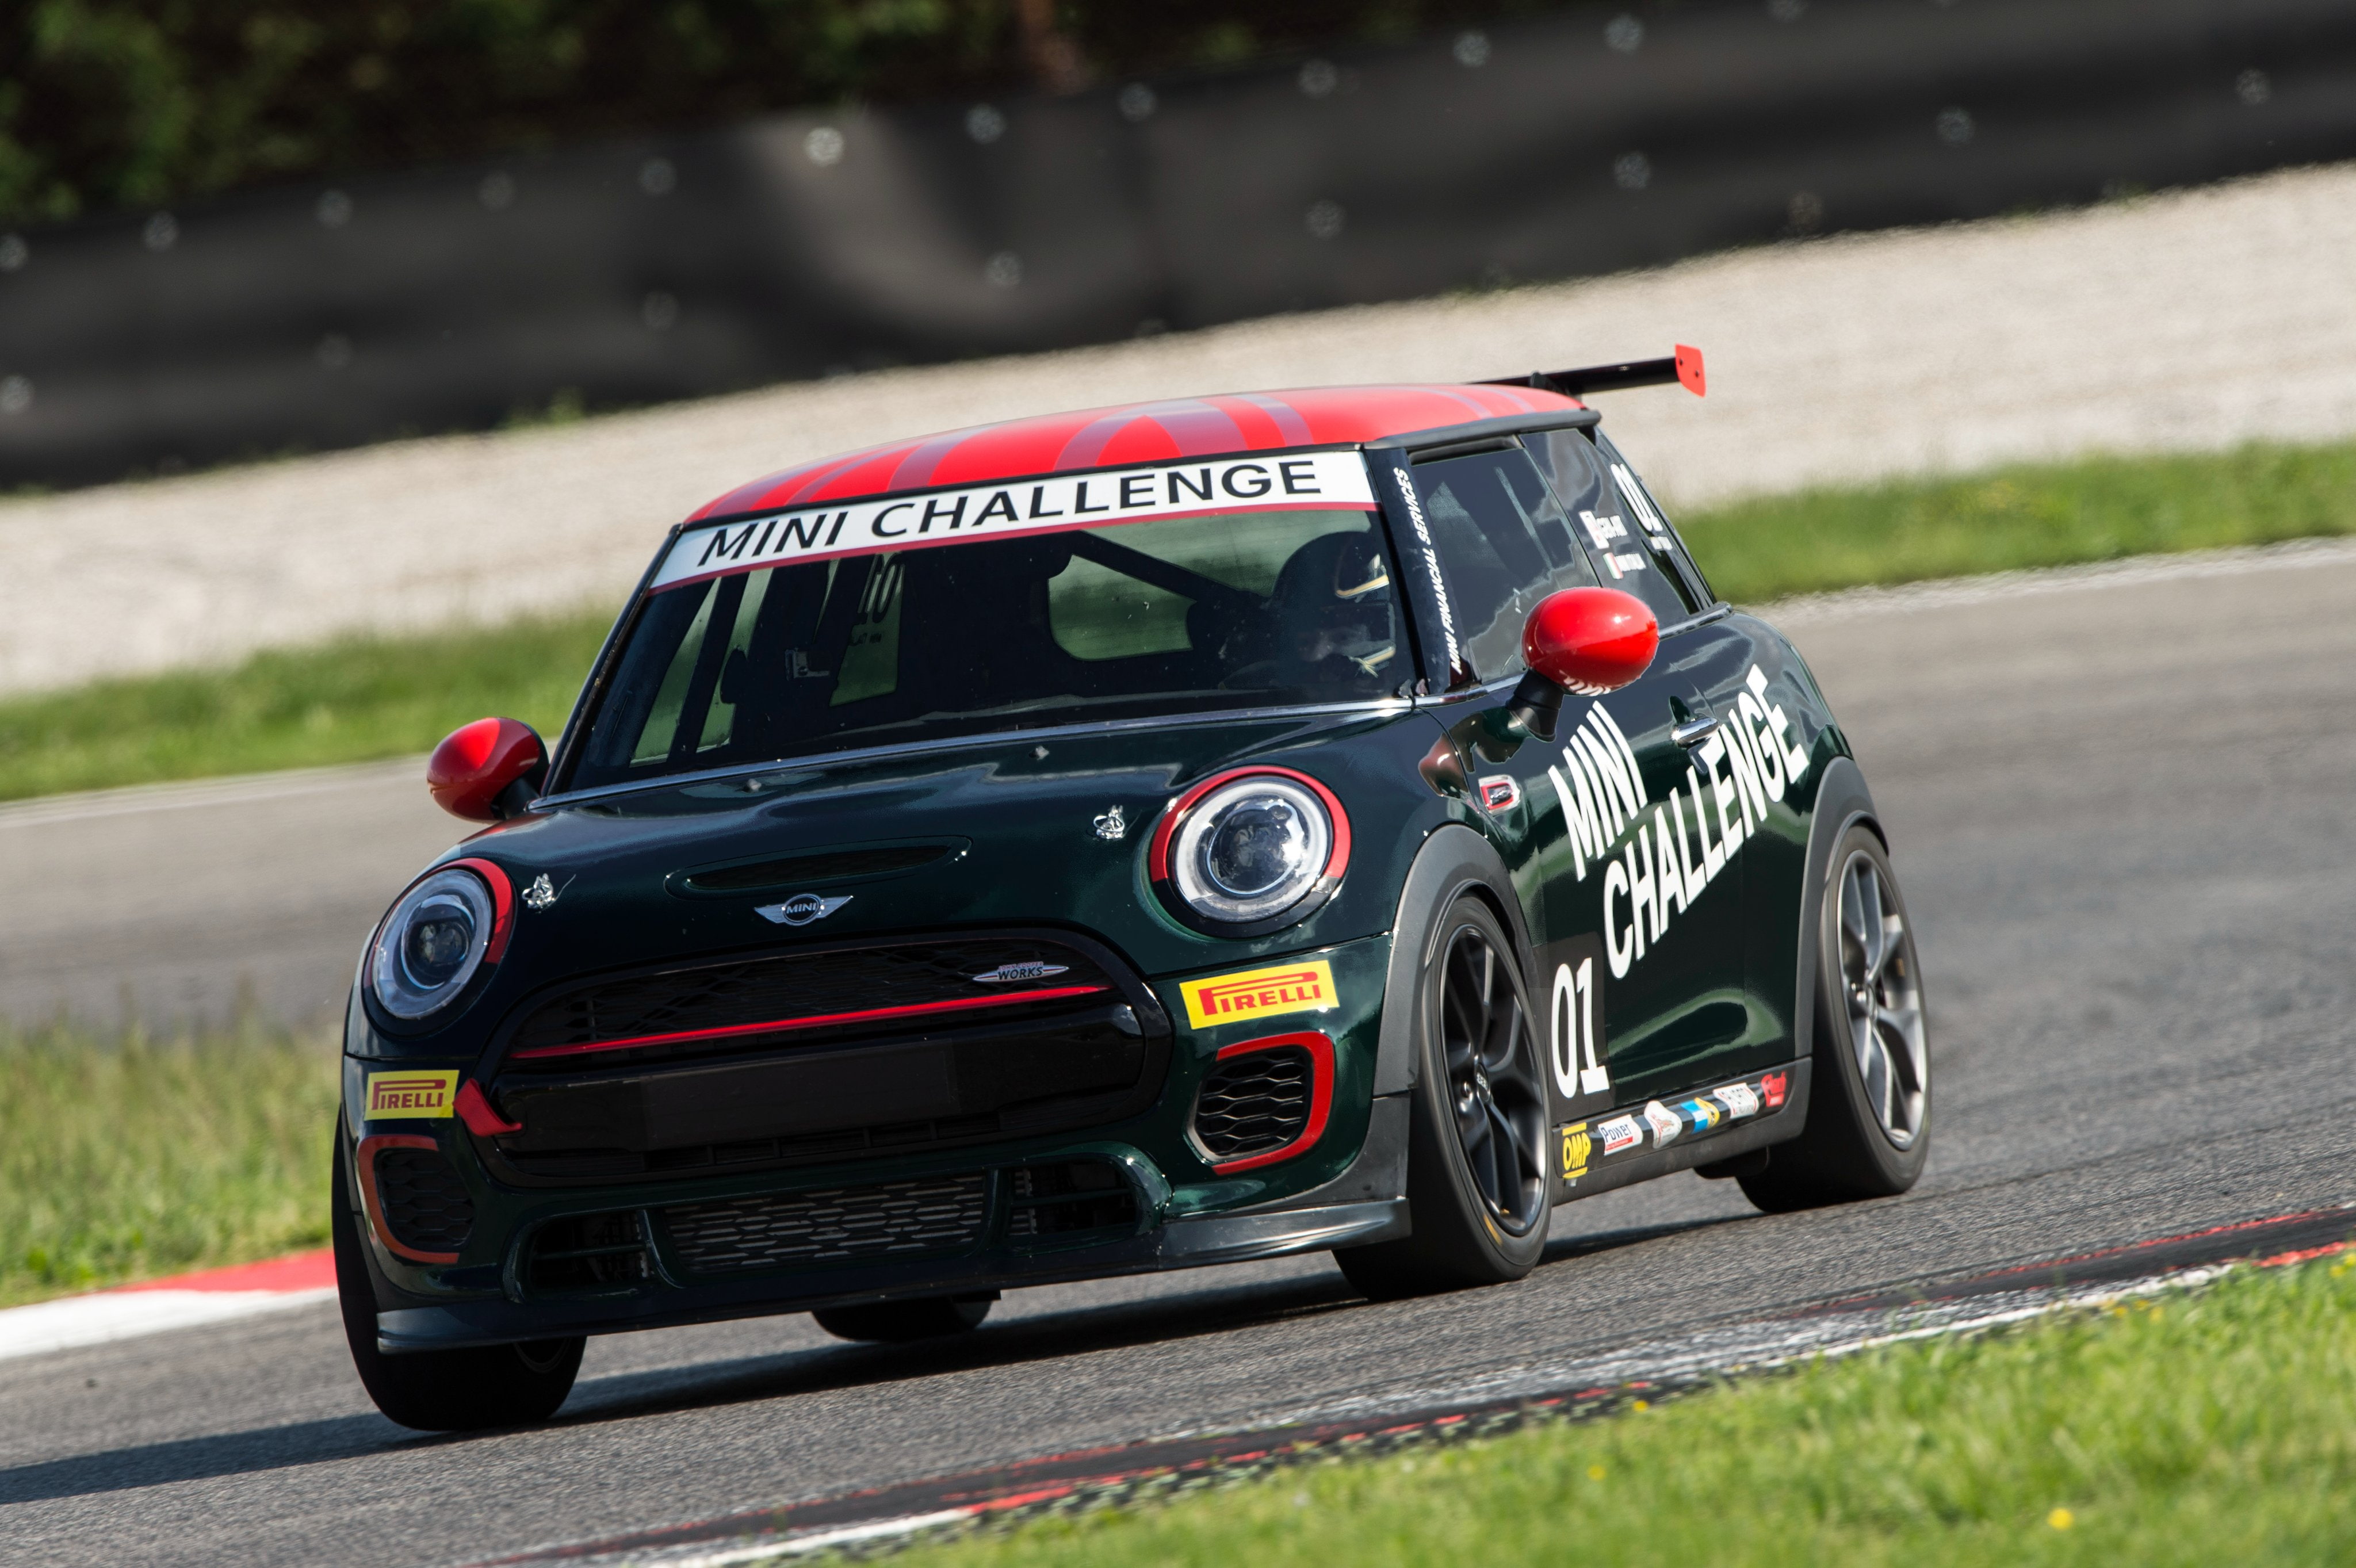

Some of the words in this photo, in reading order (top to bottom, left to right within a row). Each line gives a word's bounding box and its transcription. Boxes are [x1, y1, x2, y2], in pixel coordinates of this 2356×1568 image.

[697, 510, 850, 567] MINI
[871, 461, 1321, 537] CHALLENGE
[1393, 466, 1432, 546] SERVICES
[1422, 548, 1455, 634] FINANCIAL
[1547, 700, 1648, 882] MINI
[1603, 663, 1810, 979] CHALLENGE
[786, 902, 817, 914] MINI
[997, 966, 1043, 980] WORKS
[1198, 971, 1322, 1016] PIRELLI
[1551, 957, 1610, 1099] 01
[371, 1079, 446, 1111] PIRELLI
[1562, 1131, 1592, 1171] OMP
